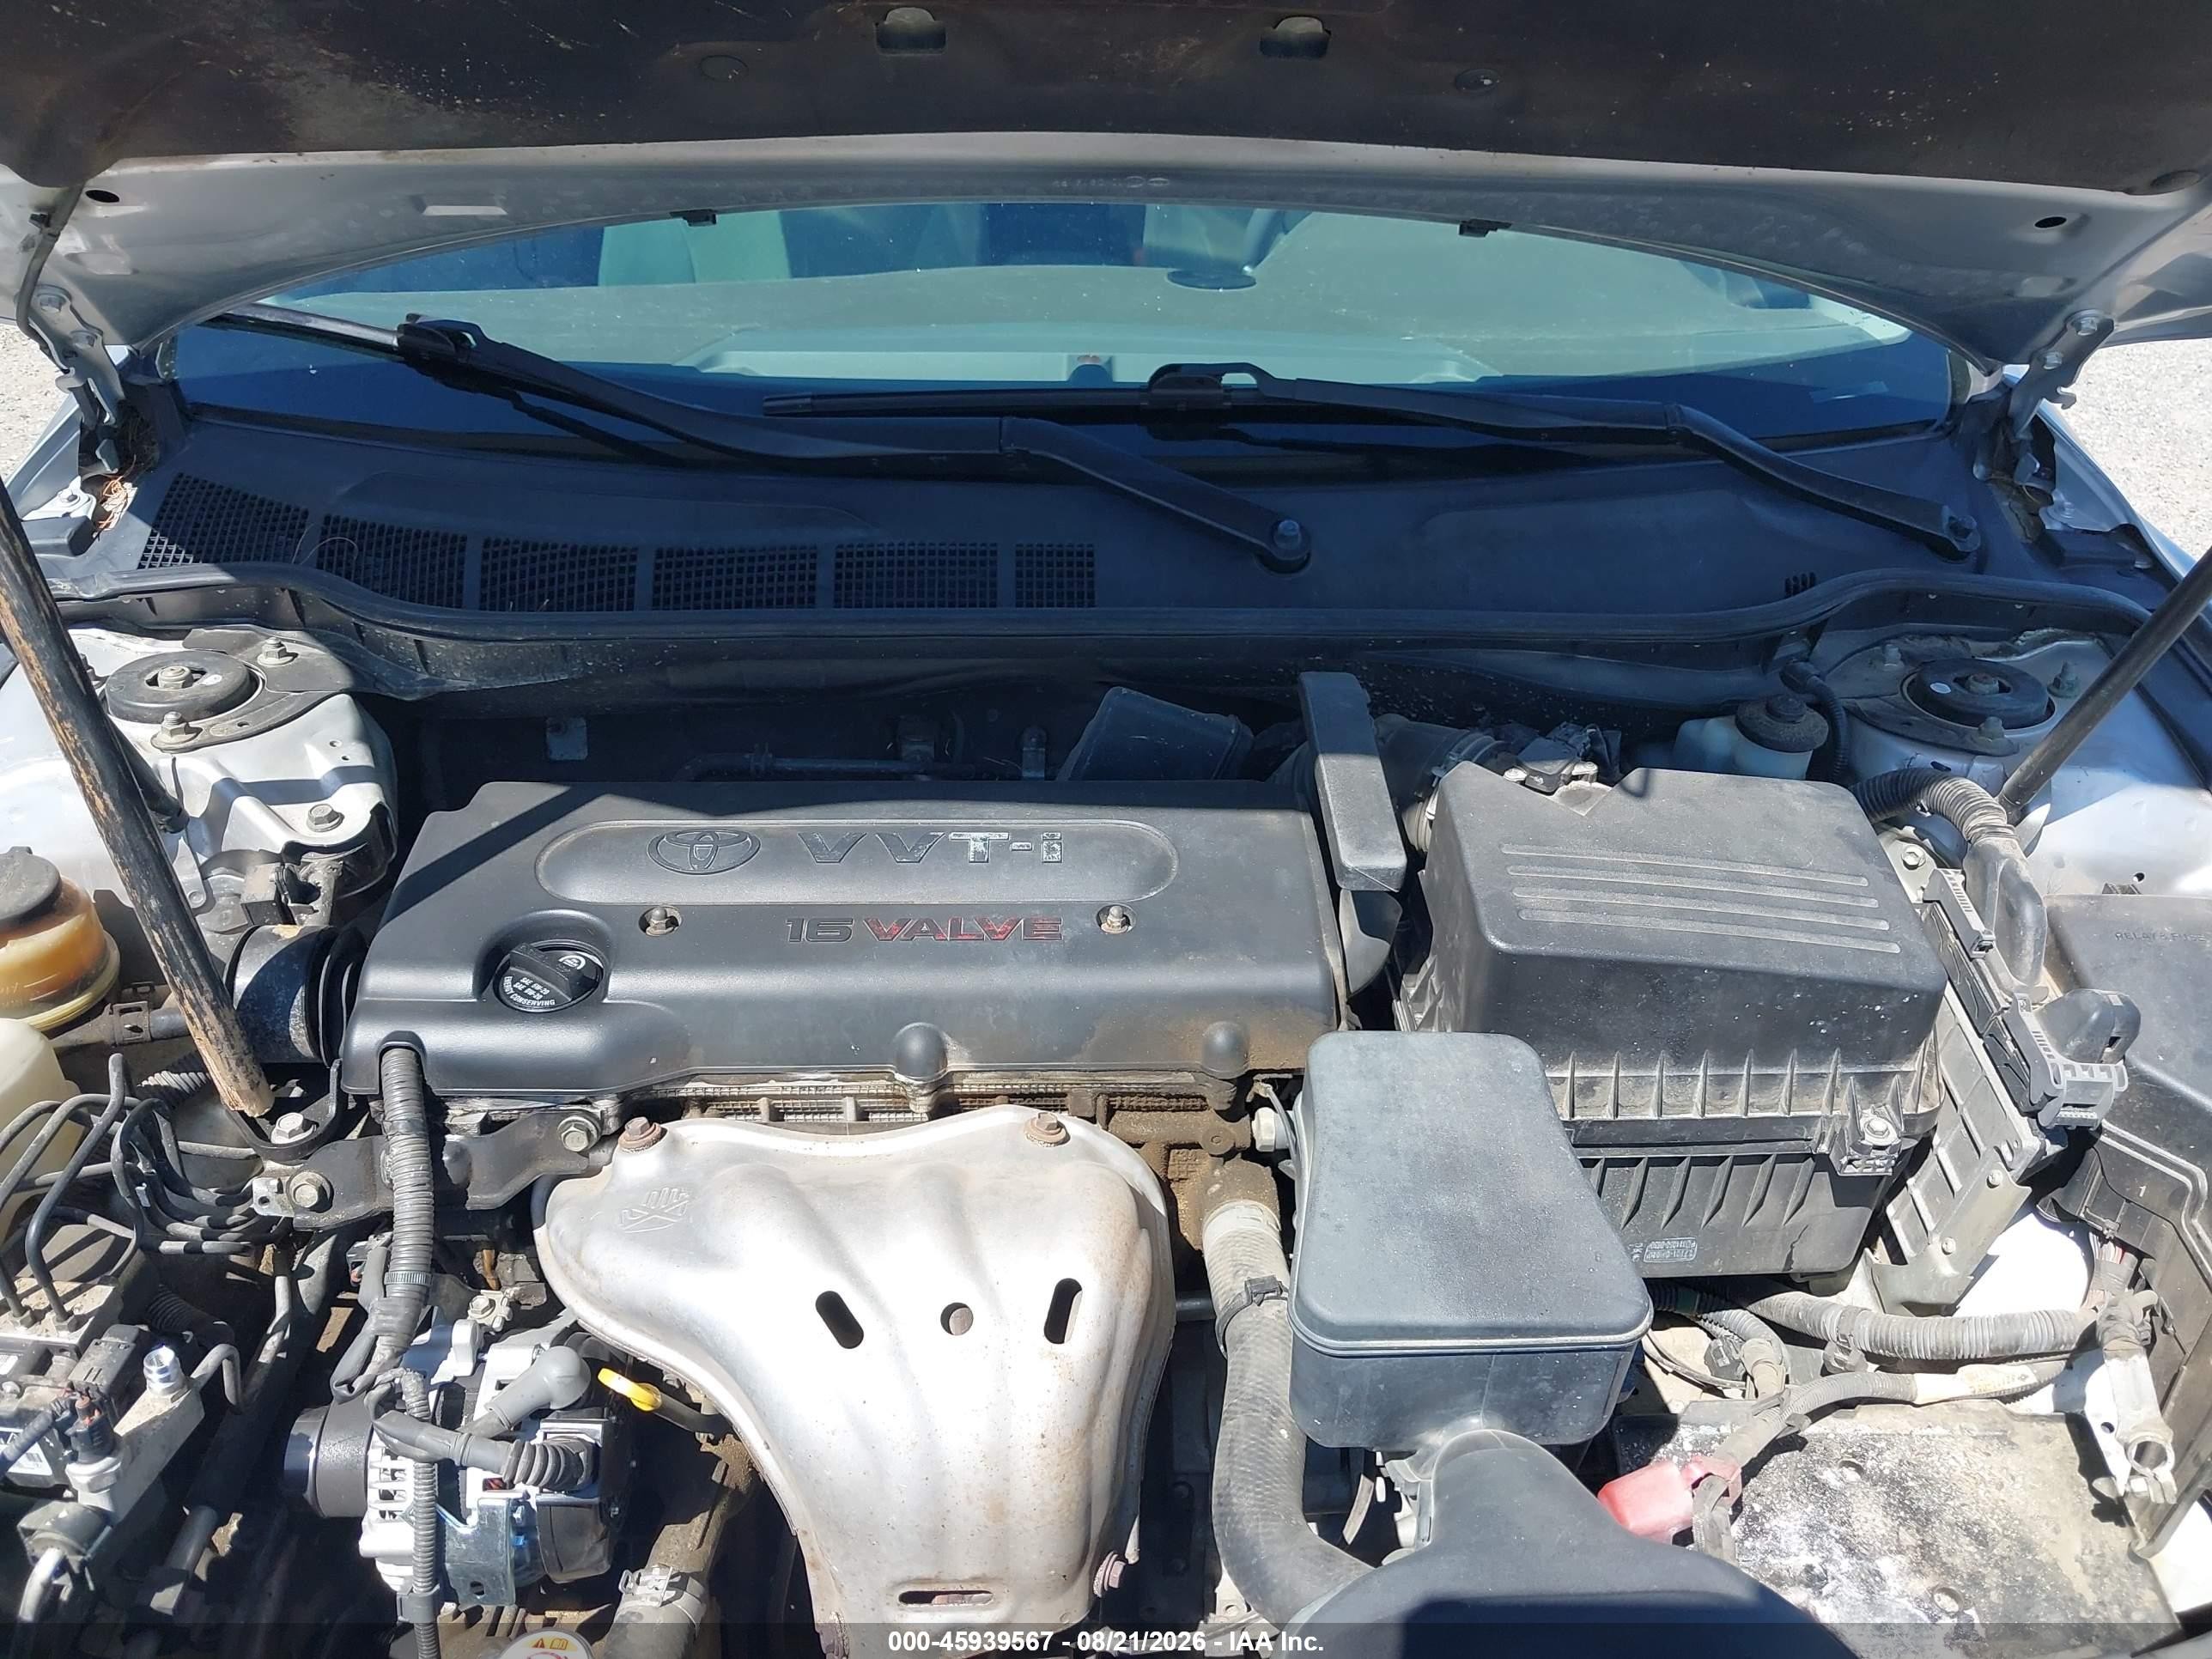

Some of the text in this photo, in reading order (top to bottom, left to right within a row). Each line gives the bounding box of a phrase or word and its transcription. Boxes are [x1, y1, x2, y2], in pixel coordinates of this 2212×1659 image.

[798, 831, 1063, 863] VVT-i
[785, 917, 1064, 943] 16 VALVE
[502, 975, 556, 1006] ENERGY CONSERVING
[513, 981, 526, 991] SAE
[520, 976, 533, 986] SAE
